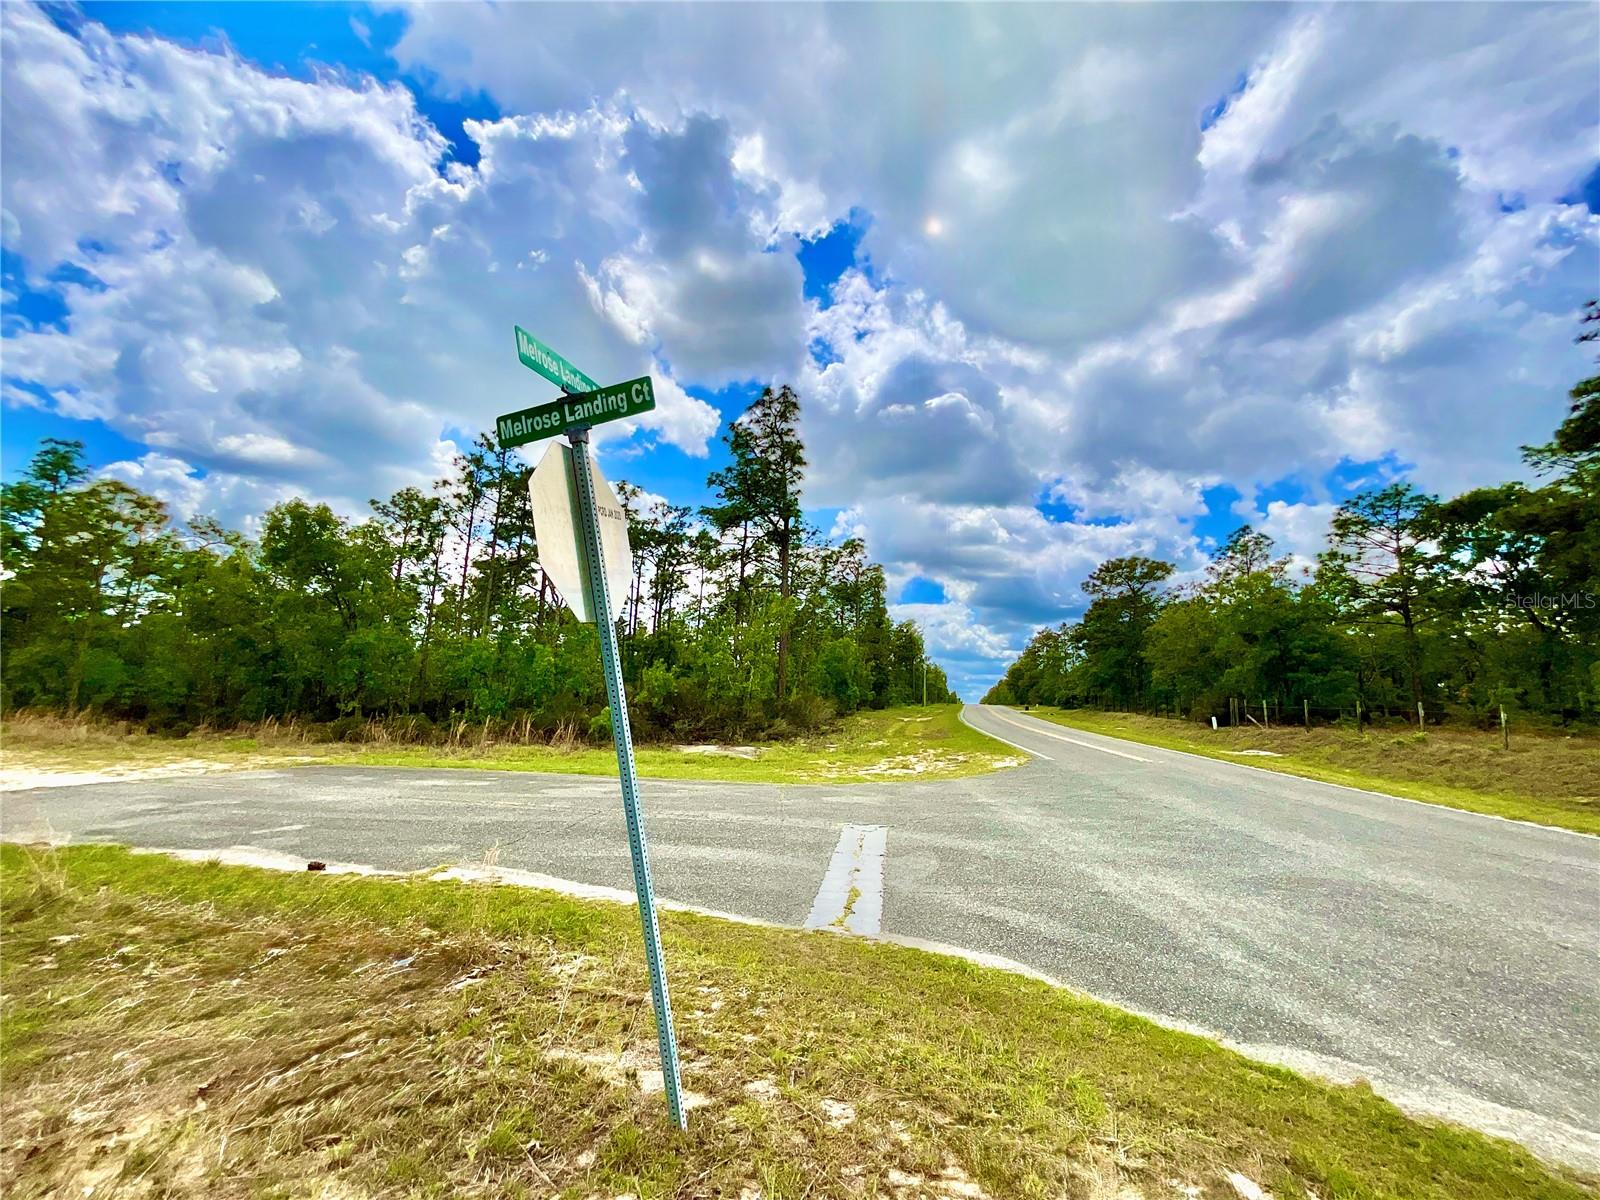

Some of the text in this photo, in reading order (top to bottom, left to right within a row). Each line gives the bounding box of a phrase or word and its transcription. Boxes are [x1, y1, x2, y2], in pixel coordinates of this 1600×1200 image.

[518, 331, 559, 375] Melrose
[500, 382, 650, 440] Melrose Landing Ct
